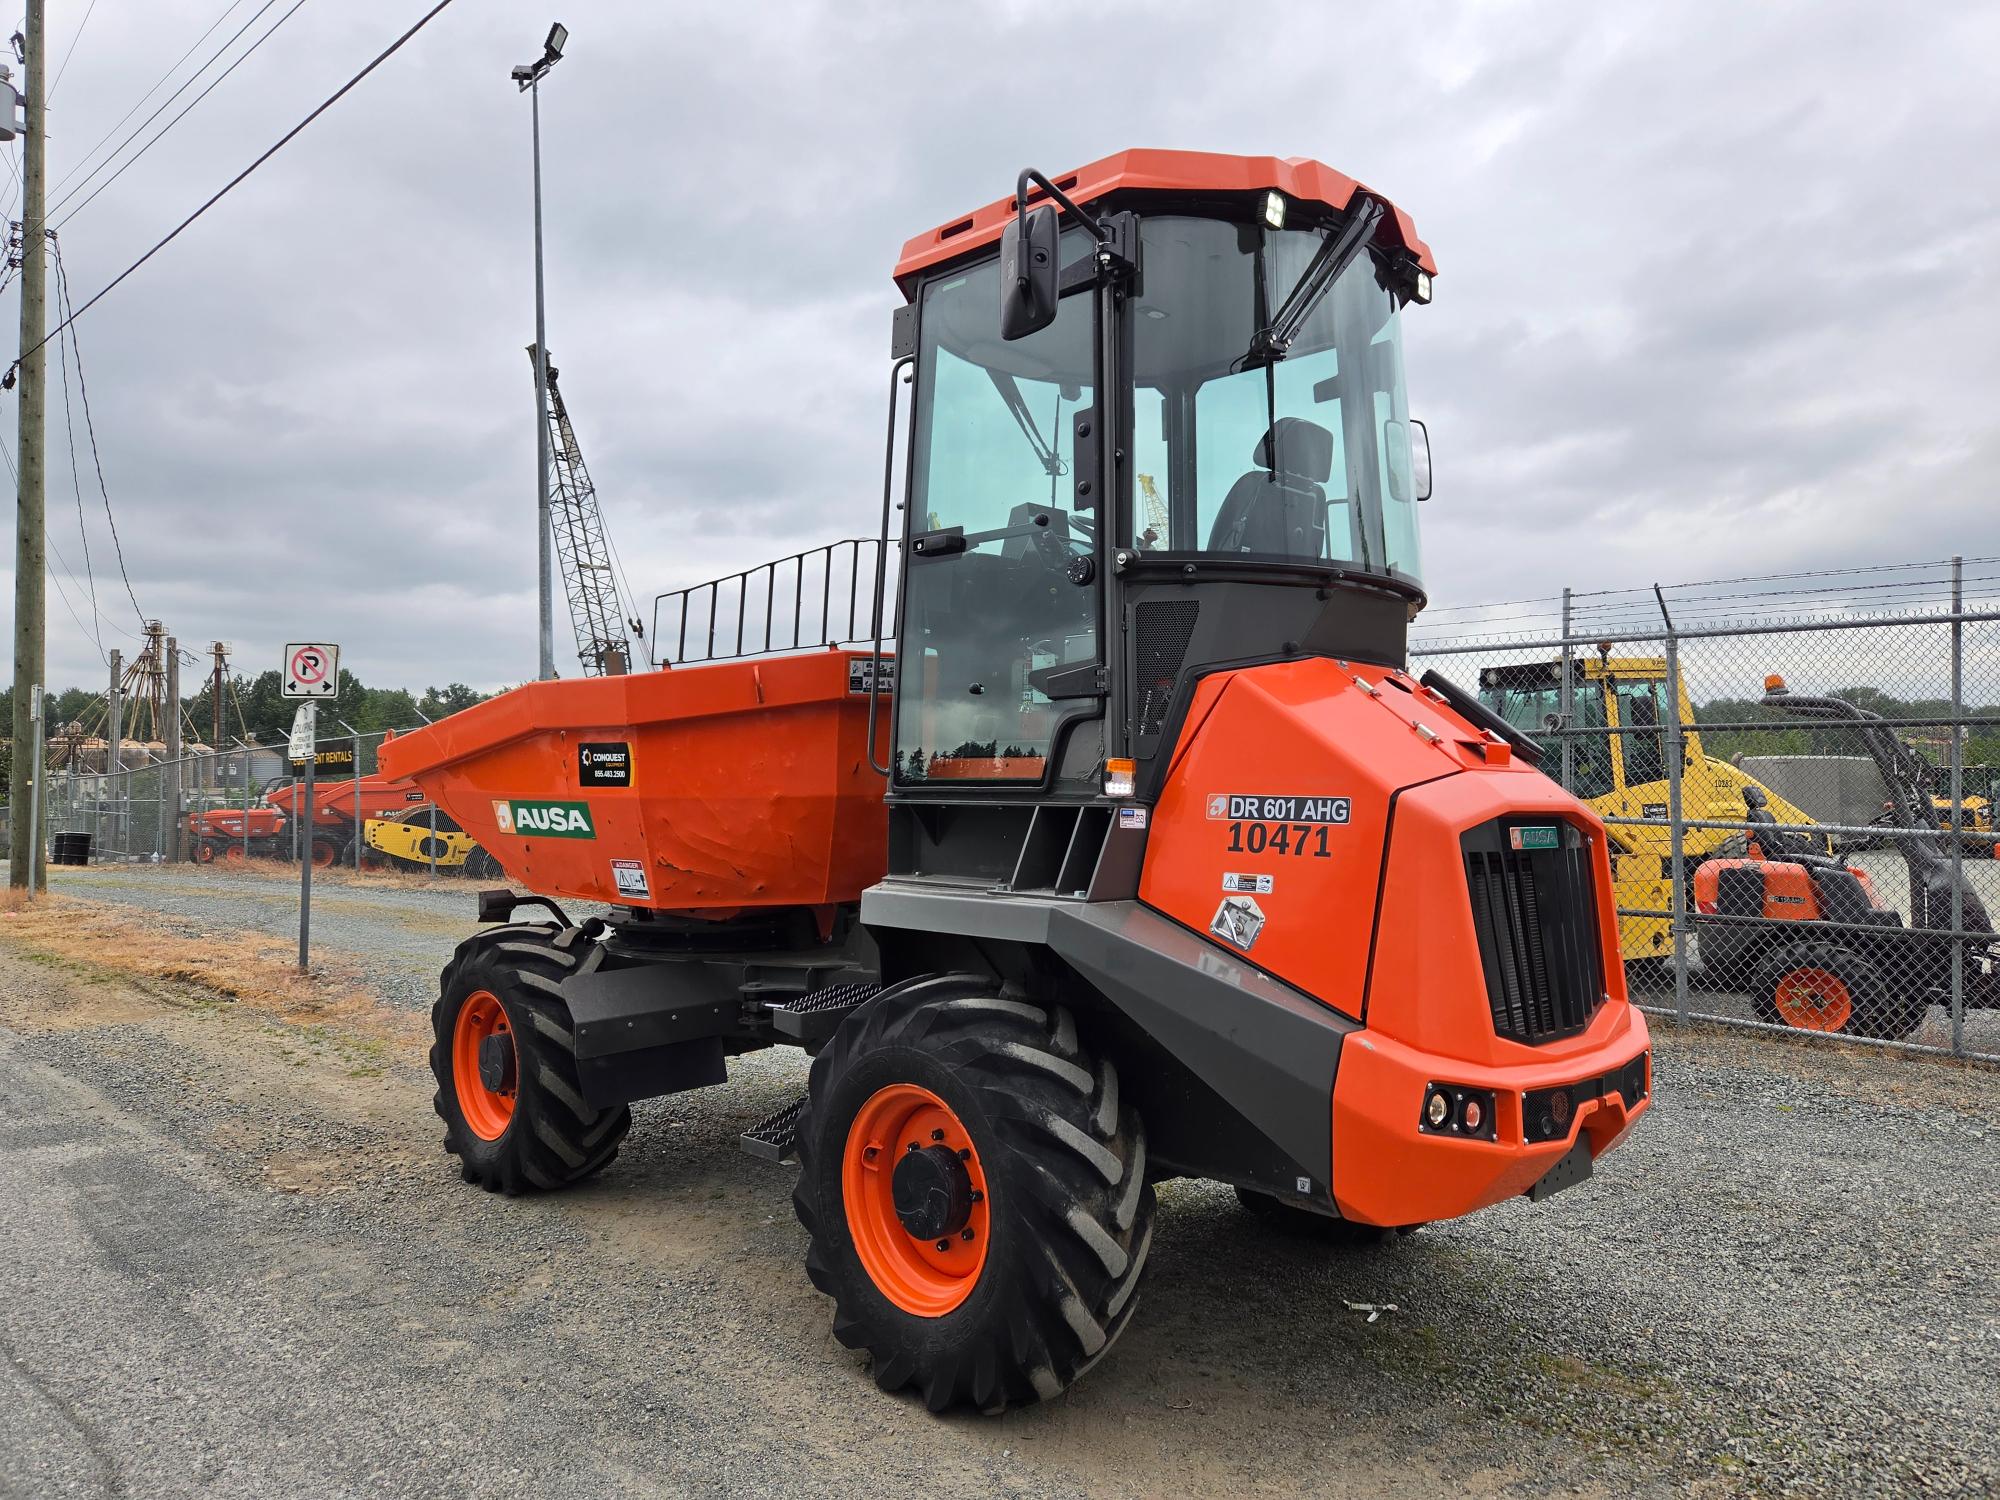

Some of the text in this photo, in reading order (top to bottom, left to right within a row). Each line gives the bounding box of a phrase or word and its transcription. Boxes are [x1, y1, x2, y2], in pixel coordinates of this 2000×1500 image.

[325, 750, 352, 764] RENTALS
[593, 753, 626, 762] CONQUEST
[1230, 797, 1348, 821] DR 601 AHG
[517, 807, 591, 832] AUSA
[1227, 822, 1331, 858] 10471
[1523, 830, 1554, 845] AUSA
